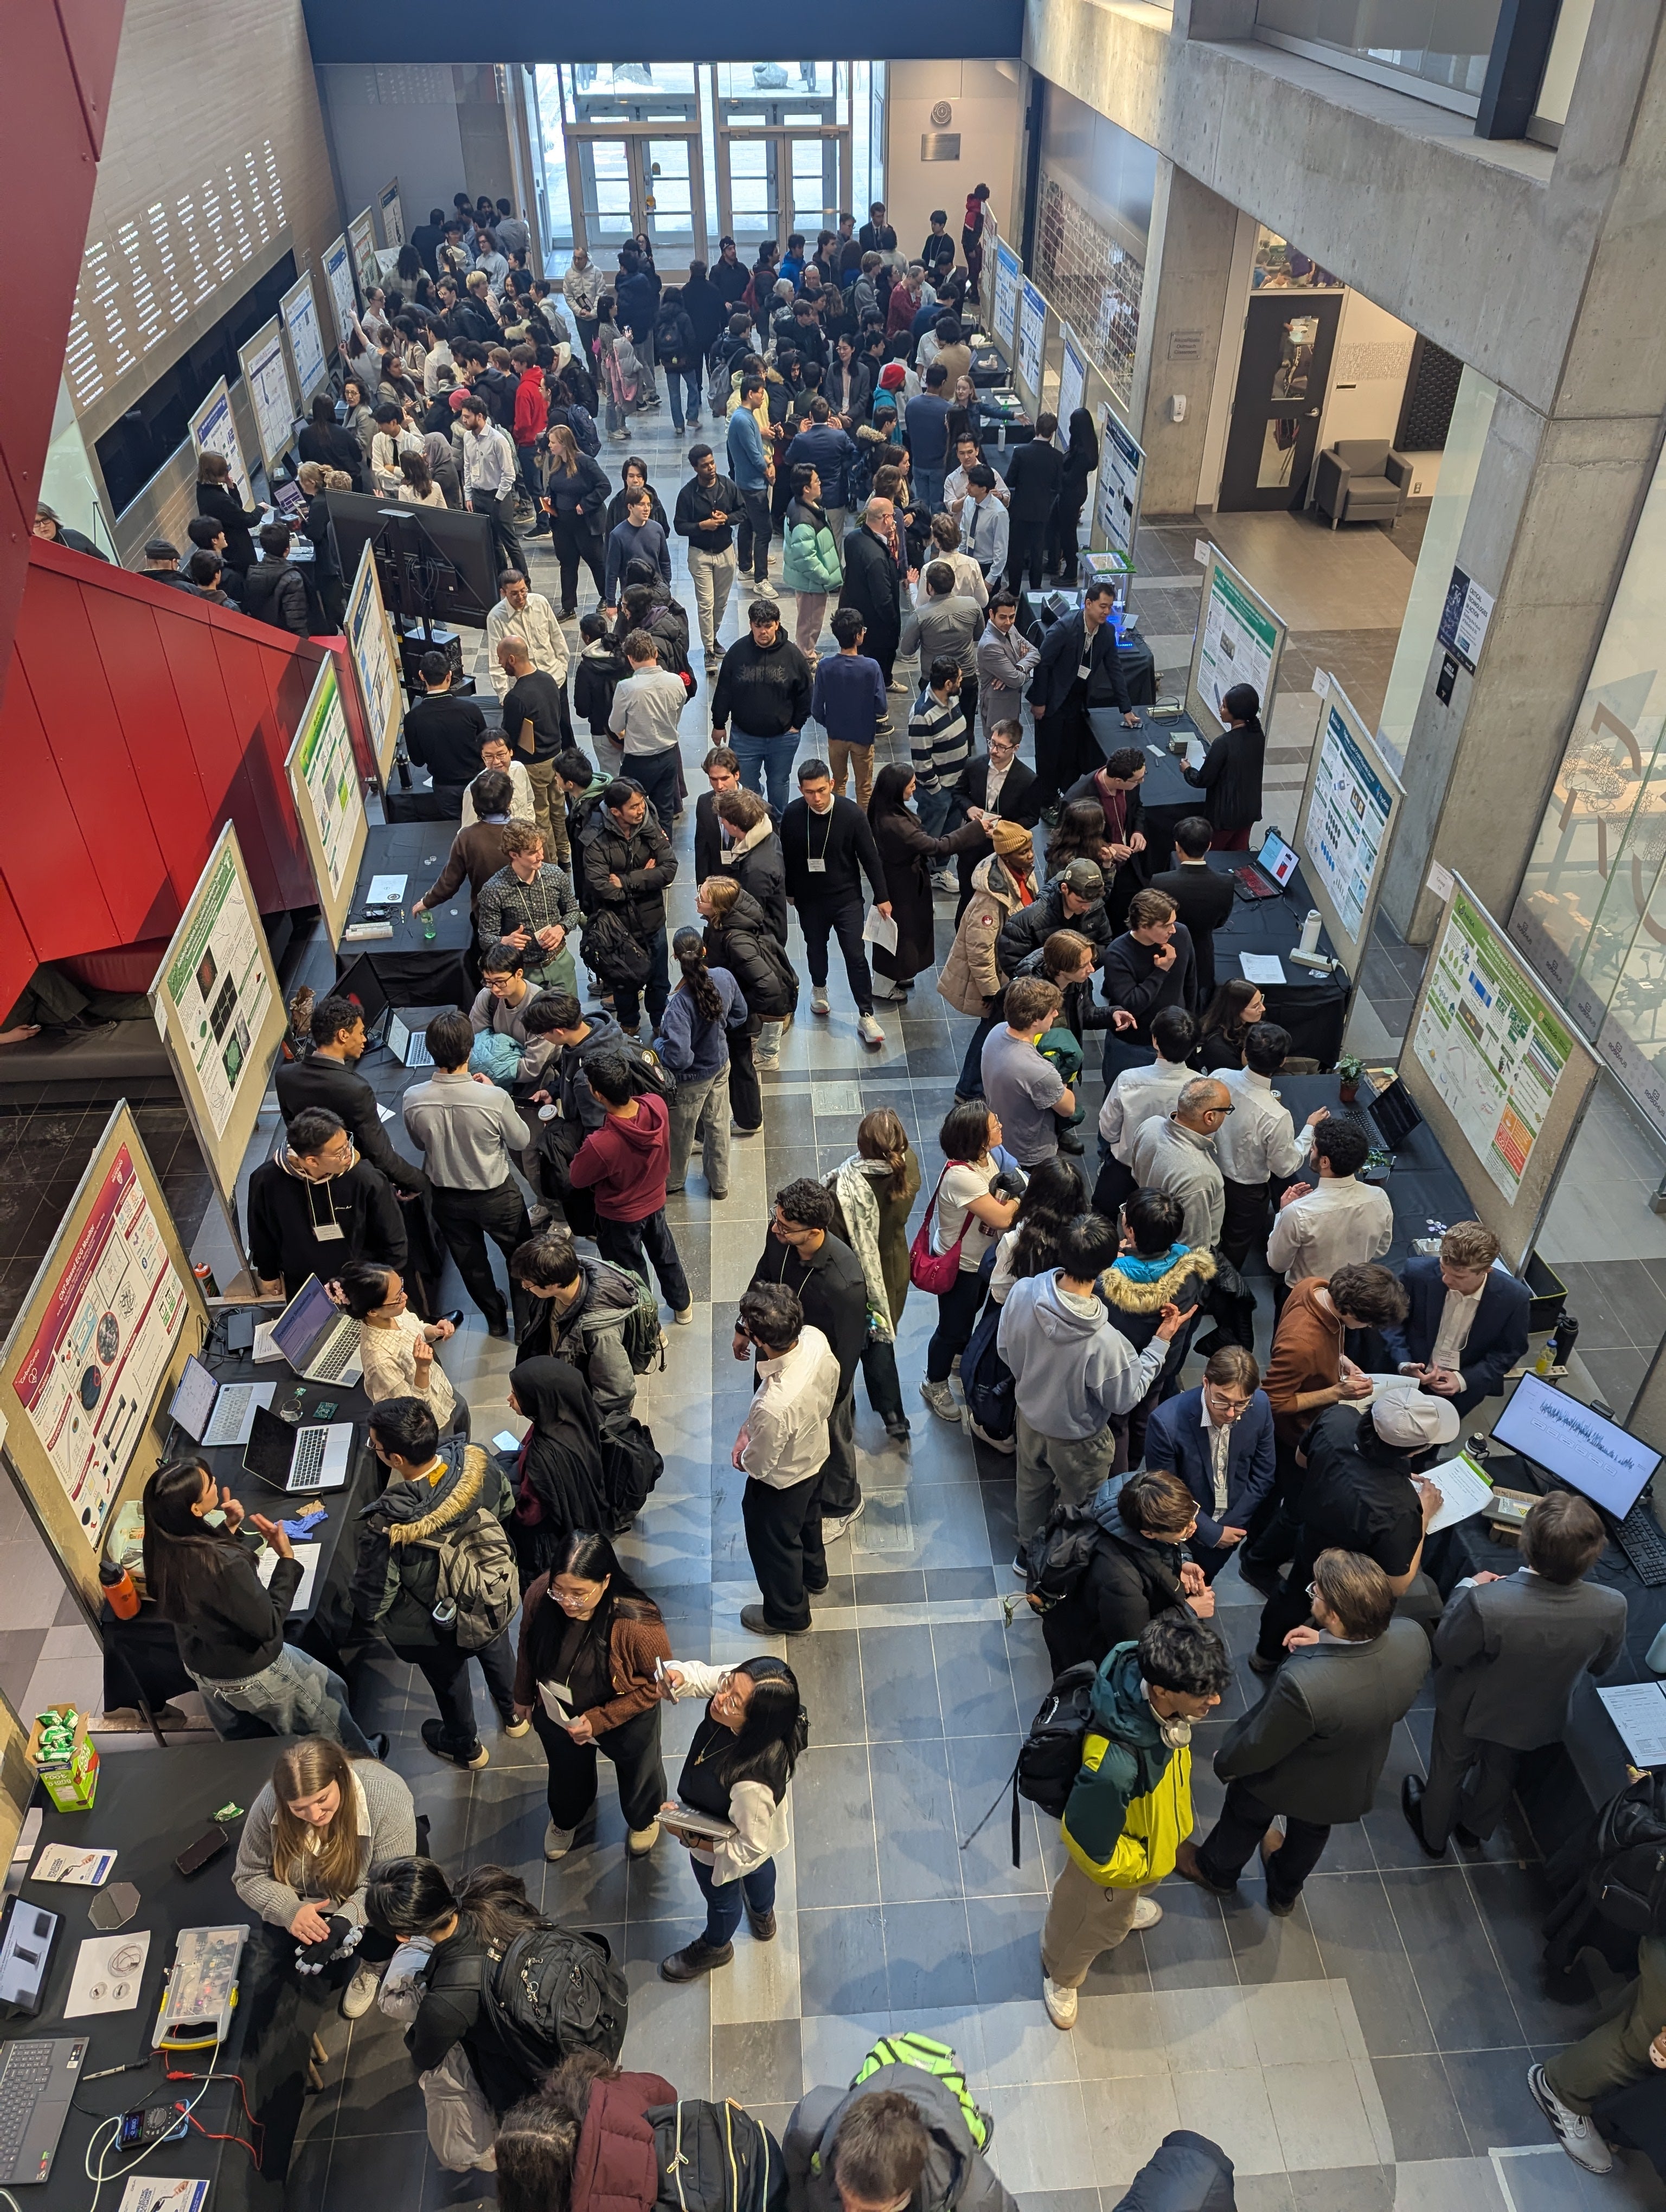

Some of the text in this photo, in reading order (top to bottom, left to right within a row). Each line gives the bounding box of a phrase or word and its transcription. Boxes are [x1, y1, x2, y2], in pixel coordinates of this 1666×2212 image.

[1467, 595, 1488, 618] TECHNOLOGIES
[1469, 587, 1482, 602] CRITICAL
[1469, 605, 1479, 619] ACTION
[1464, 910, 1475, 929] NESA
[1516, 974, 1533, 1000] Agriculture
[119, 1180, 132, 1207] Conclusion
[58, 1261, 76, 1302] CNT-Based
[75, 1246, 84, 1265] ECG
[82, 1221, 95, 1250] Monitor
[278, 1315, 295, 1339] Preliminary
[128, 1329, 137, 1350] Results
[20, 1346, 40, 1386] CarbonCardio
[38, 1371, 49, 1396] Problem
[79, 1459, 89, 1487] Synthesis
